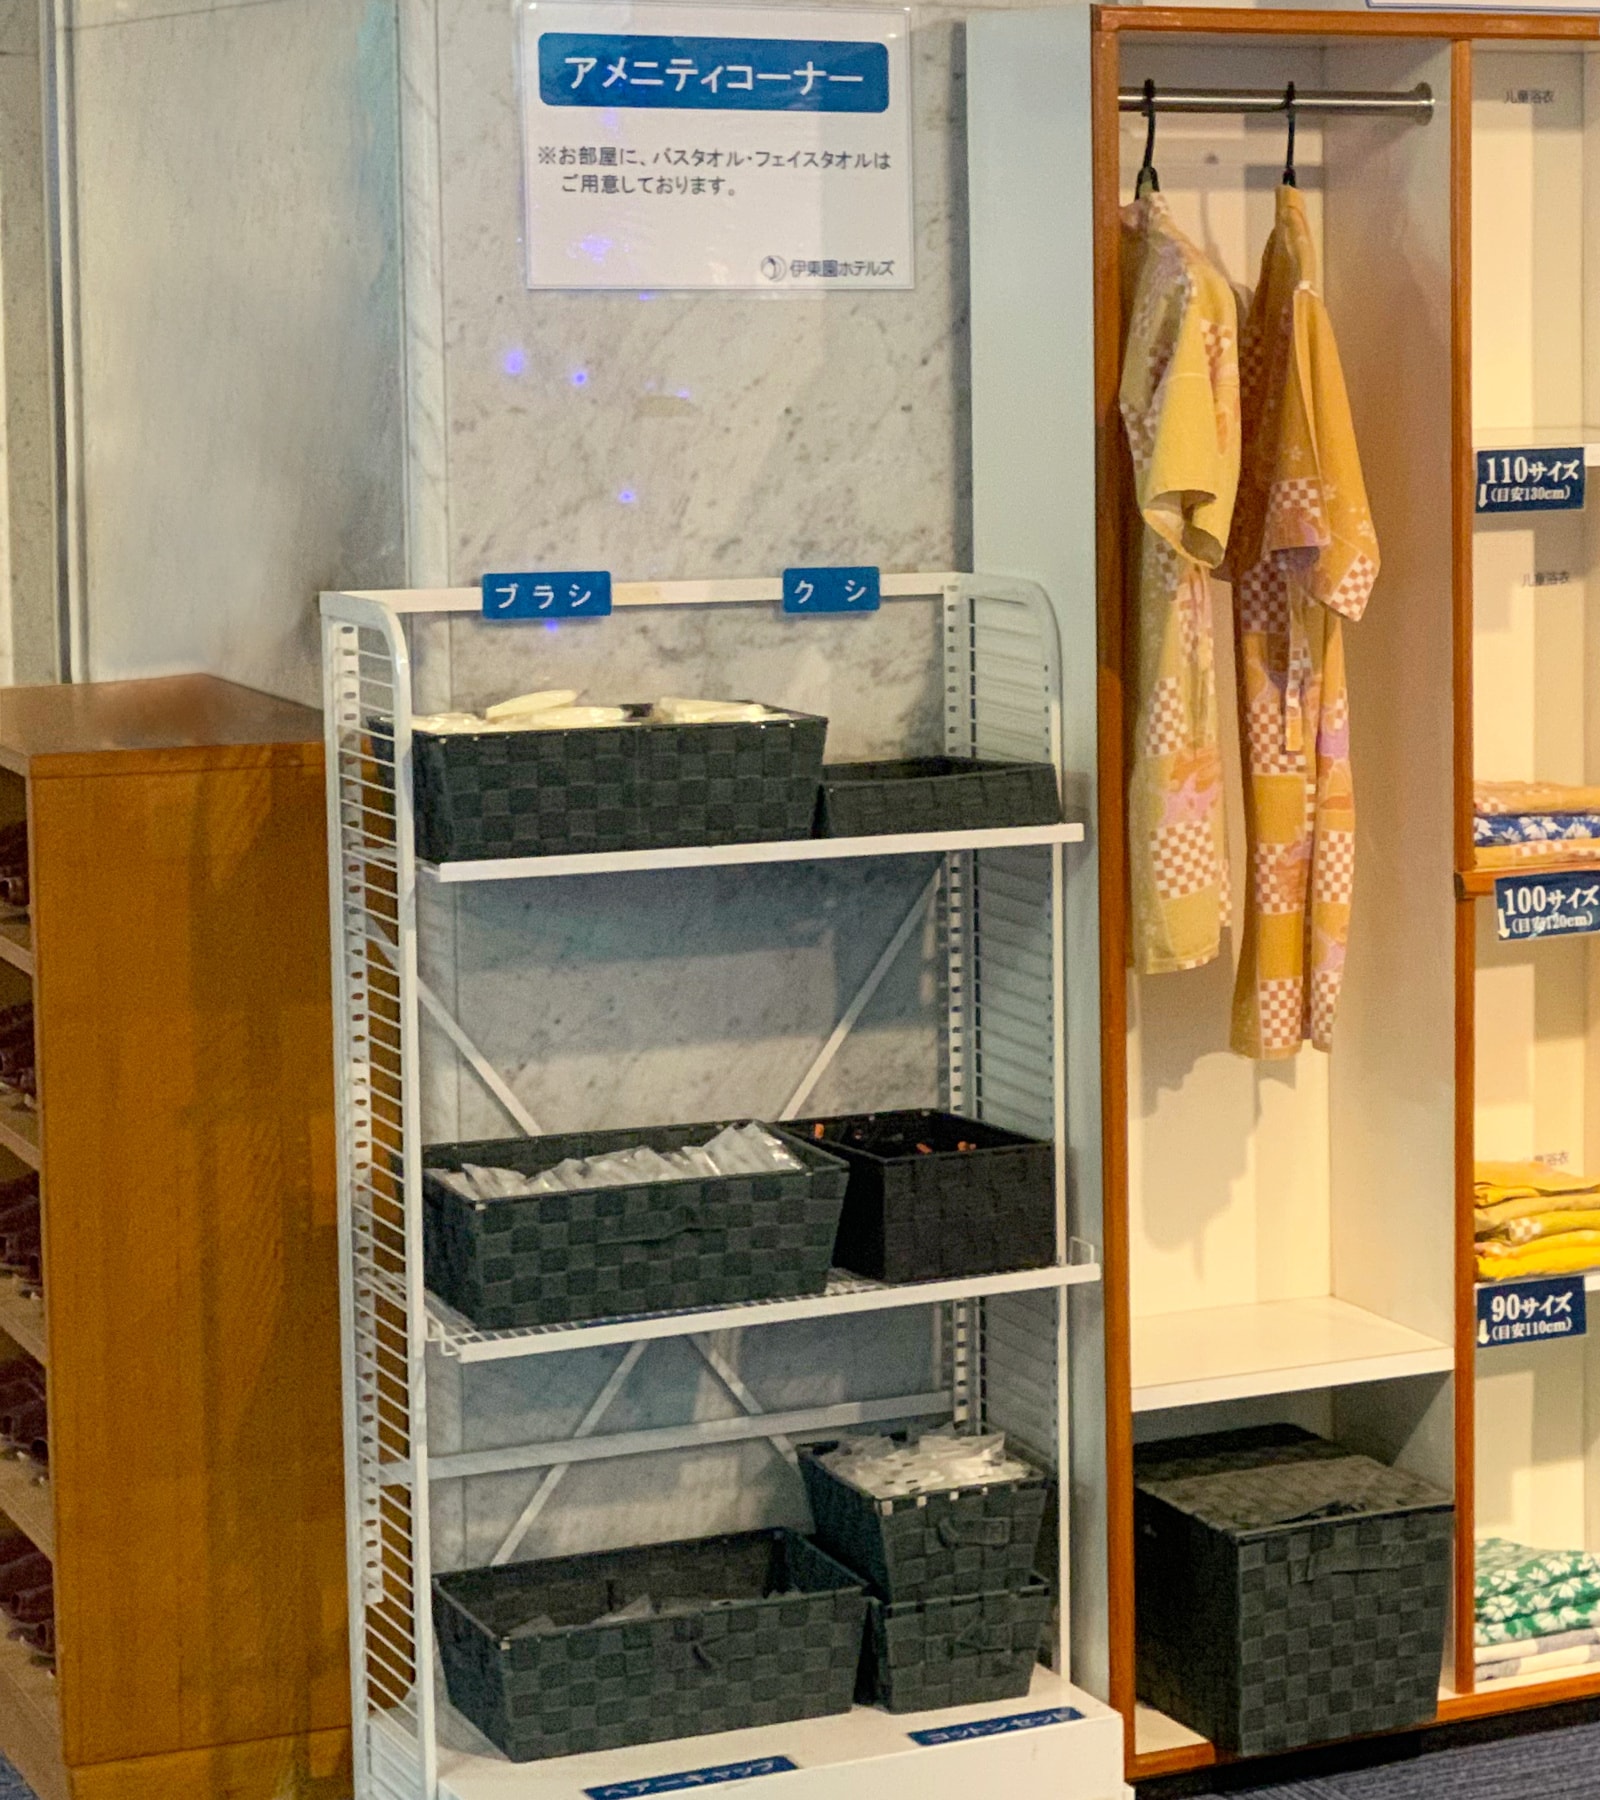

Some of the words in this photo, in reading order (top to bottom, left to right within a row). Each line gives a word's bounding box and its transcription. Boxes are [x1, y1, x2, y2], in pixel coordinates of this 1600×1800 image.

[565, 56, 863, 95] アメニティコーナー
[561, 175, 737, 197] ご用意しております。
[1486, 456, 1581, 485] 110サイズ
[495, 583, 592, 610] ブラシ
[1503, 885, 1600, 916] 100サイズ
[1491, 1292, 1573, 1322] 90サイズ
